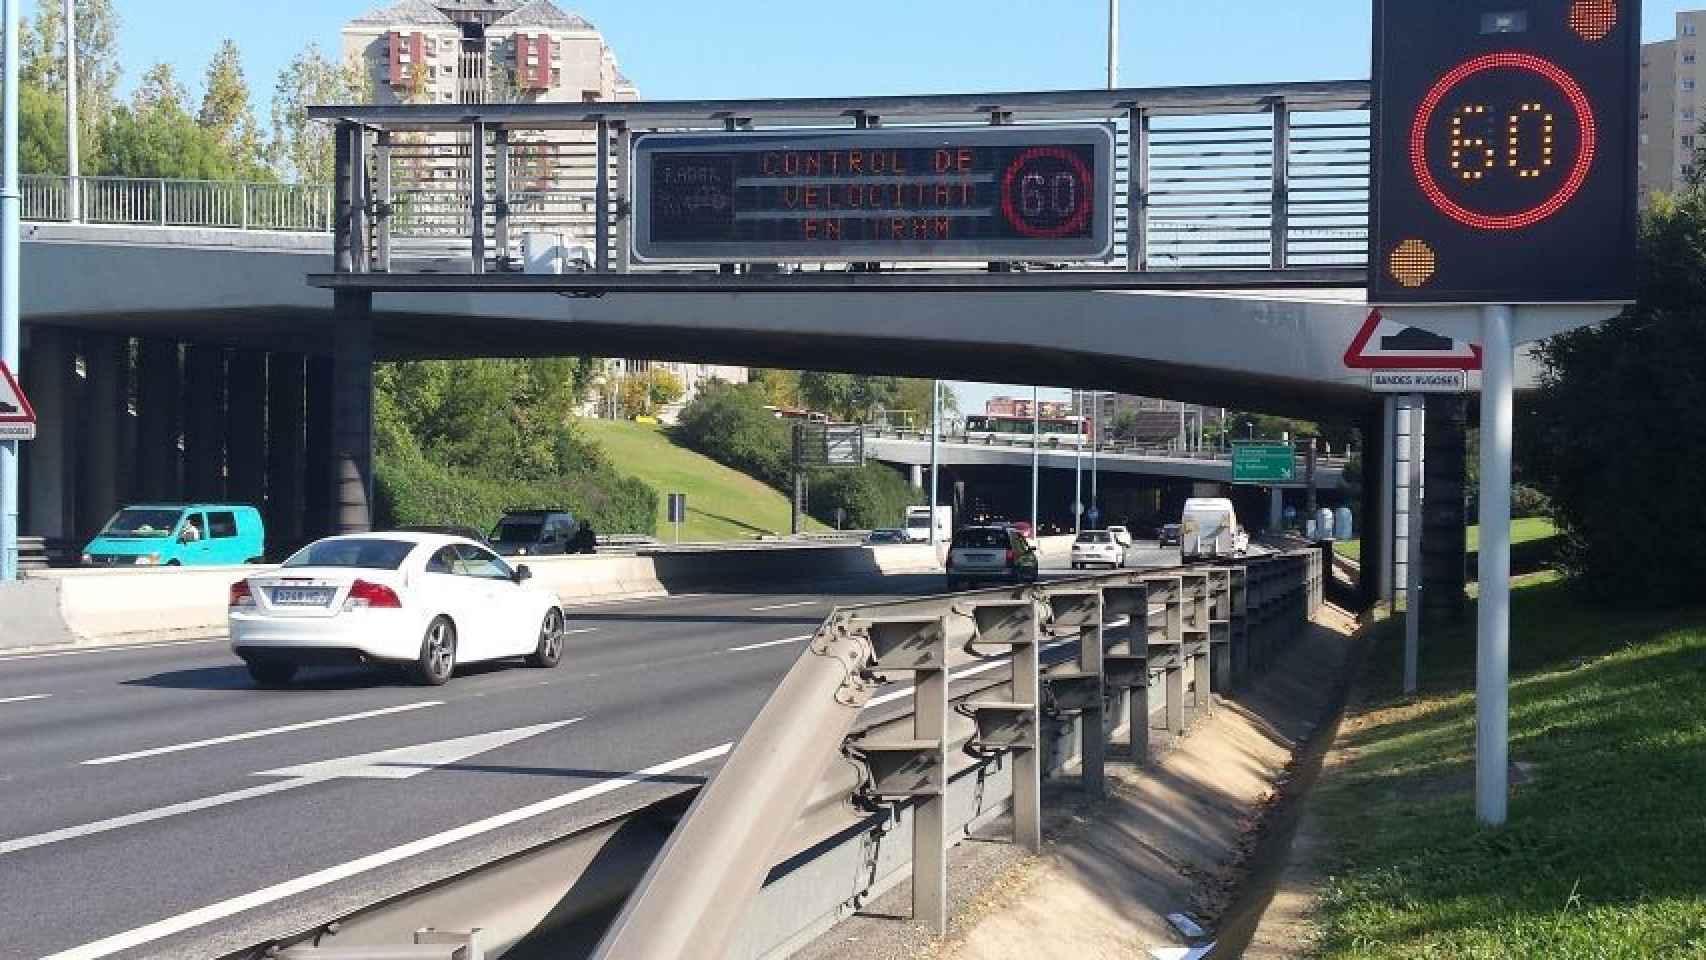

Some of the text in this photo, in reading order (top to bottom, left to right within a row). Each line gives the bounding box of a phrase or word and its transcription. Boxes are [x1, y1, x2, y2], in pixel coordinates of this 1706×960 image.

[1449, 103, 1554, 180] 60
[763, 150, 971, 175] CONTROL DE
[785, 180, 972, 208] VELOCITAT
[1021, 172, 1075, 217] 60
[805, 217, 949, 240] EN TRAM
